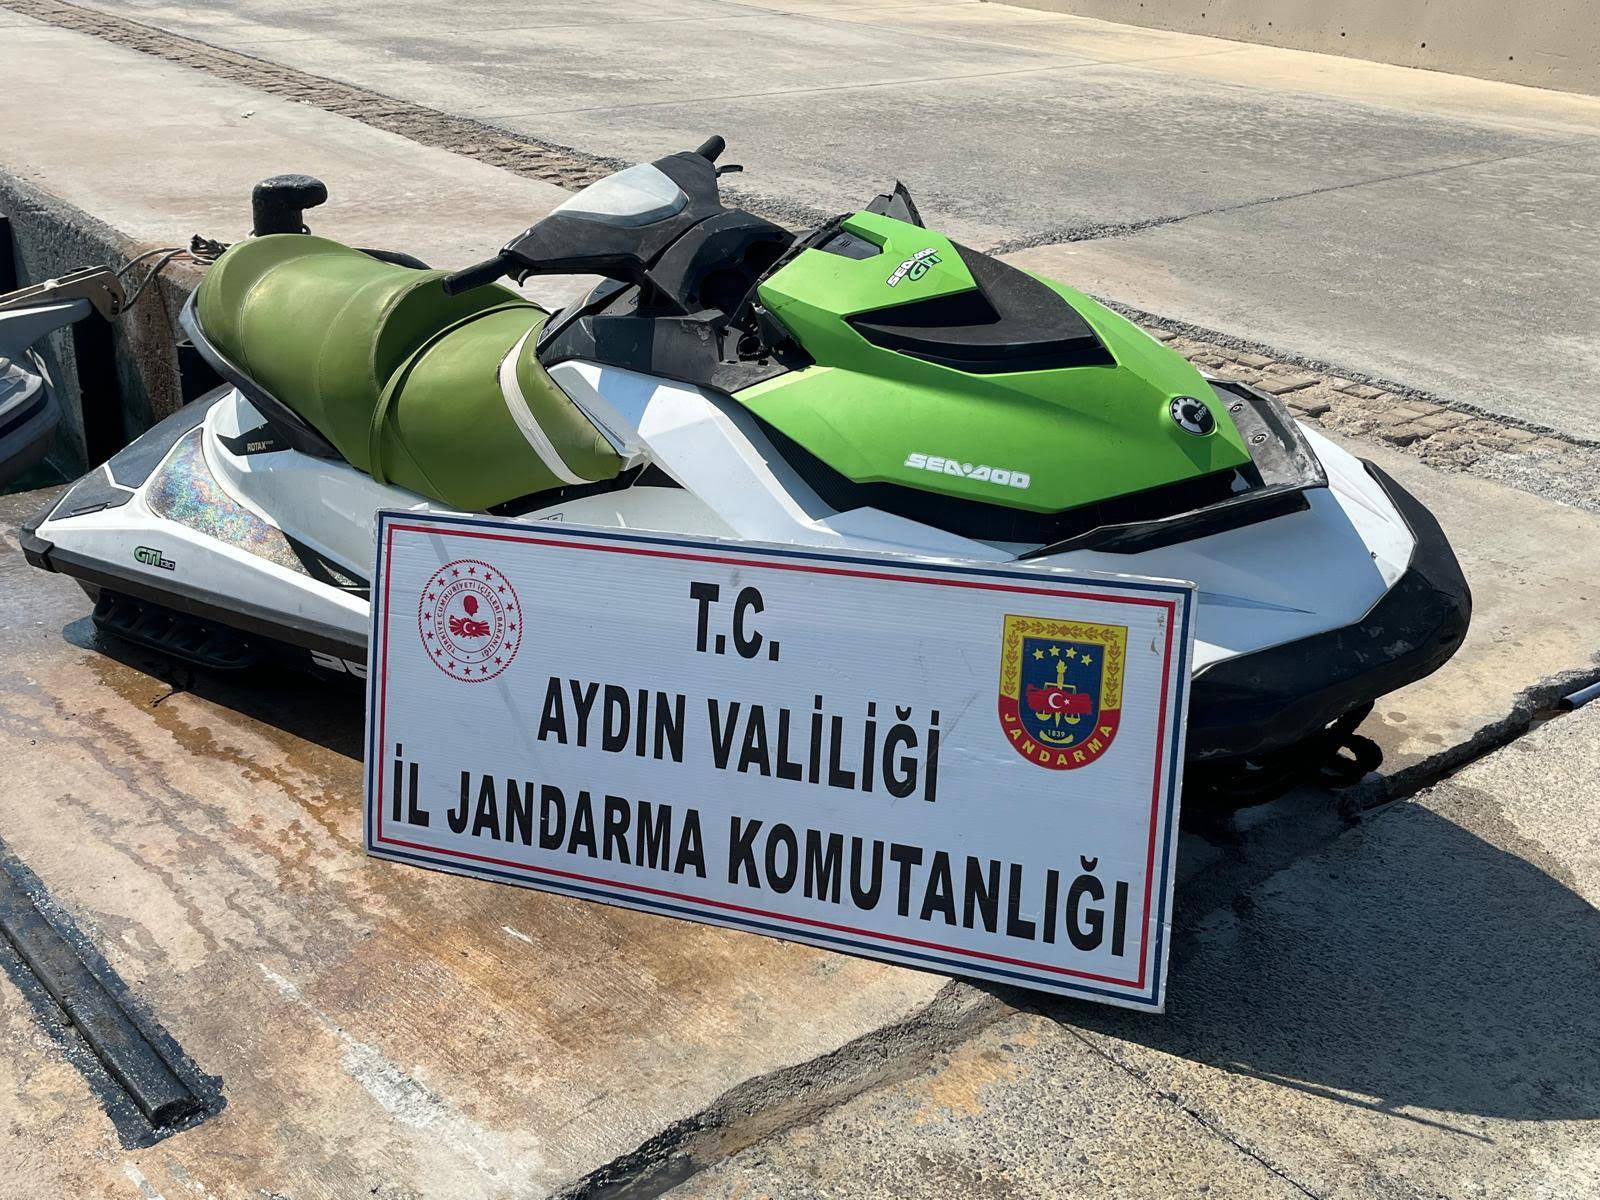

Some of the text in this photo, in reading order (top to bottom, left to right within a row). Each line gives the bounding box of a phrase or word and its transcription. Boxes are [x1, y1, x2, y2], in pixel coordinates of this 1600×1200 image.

[247, 441, 267, 453] ROTAX
[689, 581, 780, 662] T.C.
[537, 676, 940, 803] AYDIN VALİLİĞİ
[1004, 712, 1113, 765] JANDARMA
[1047, 729, 1066, 738] 1839
[393, 742, 1129, 957] İL JANDARMA KOMUTANLIĞI
